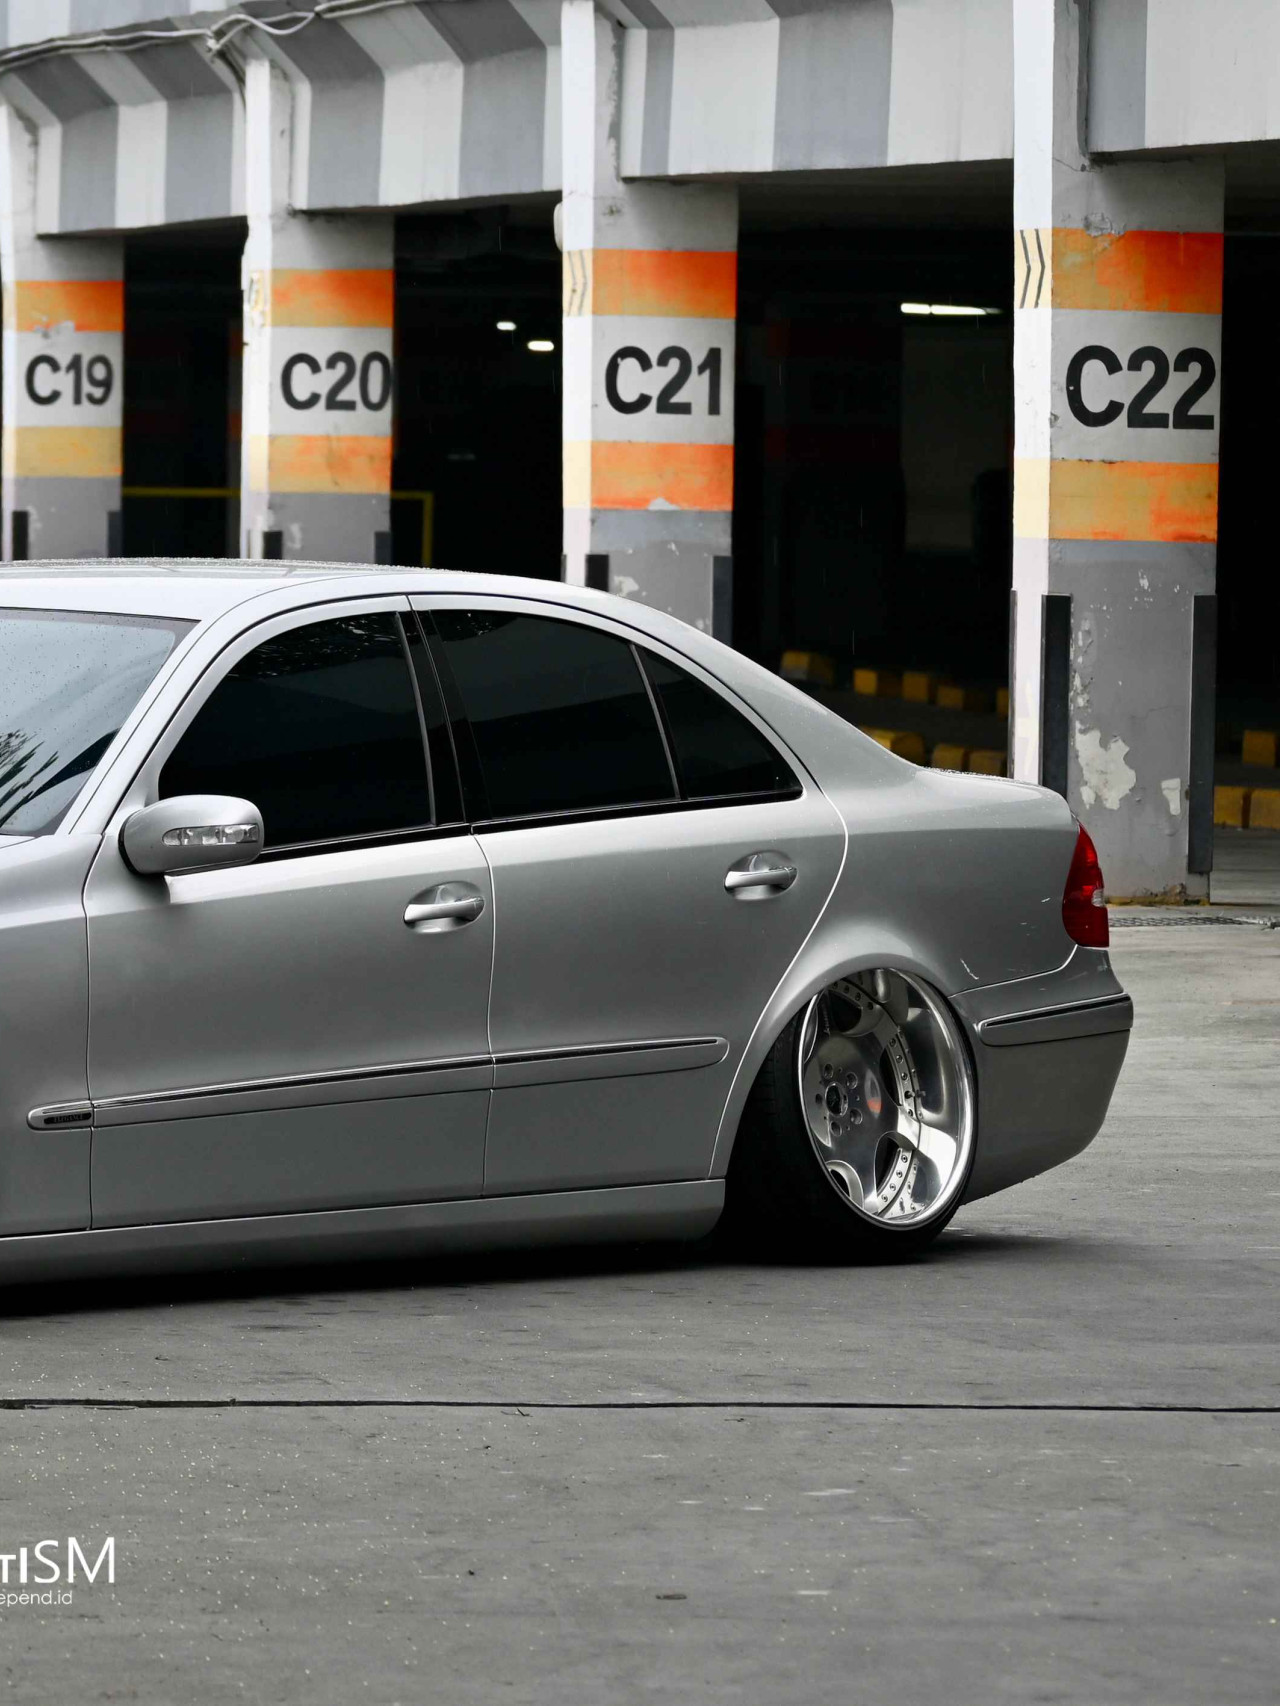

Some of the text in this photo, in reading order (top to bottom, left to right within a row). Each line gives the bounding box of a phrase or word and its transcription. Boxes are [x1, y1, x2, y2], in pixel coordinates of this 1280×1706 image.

[25, 353, 114, 407] C19
[281, 351, 392, 411] C20
[605, 345, 722, 416] C21
[1065, 344, 1217, 430] C22
